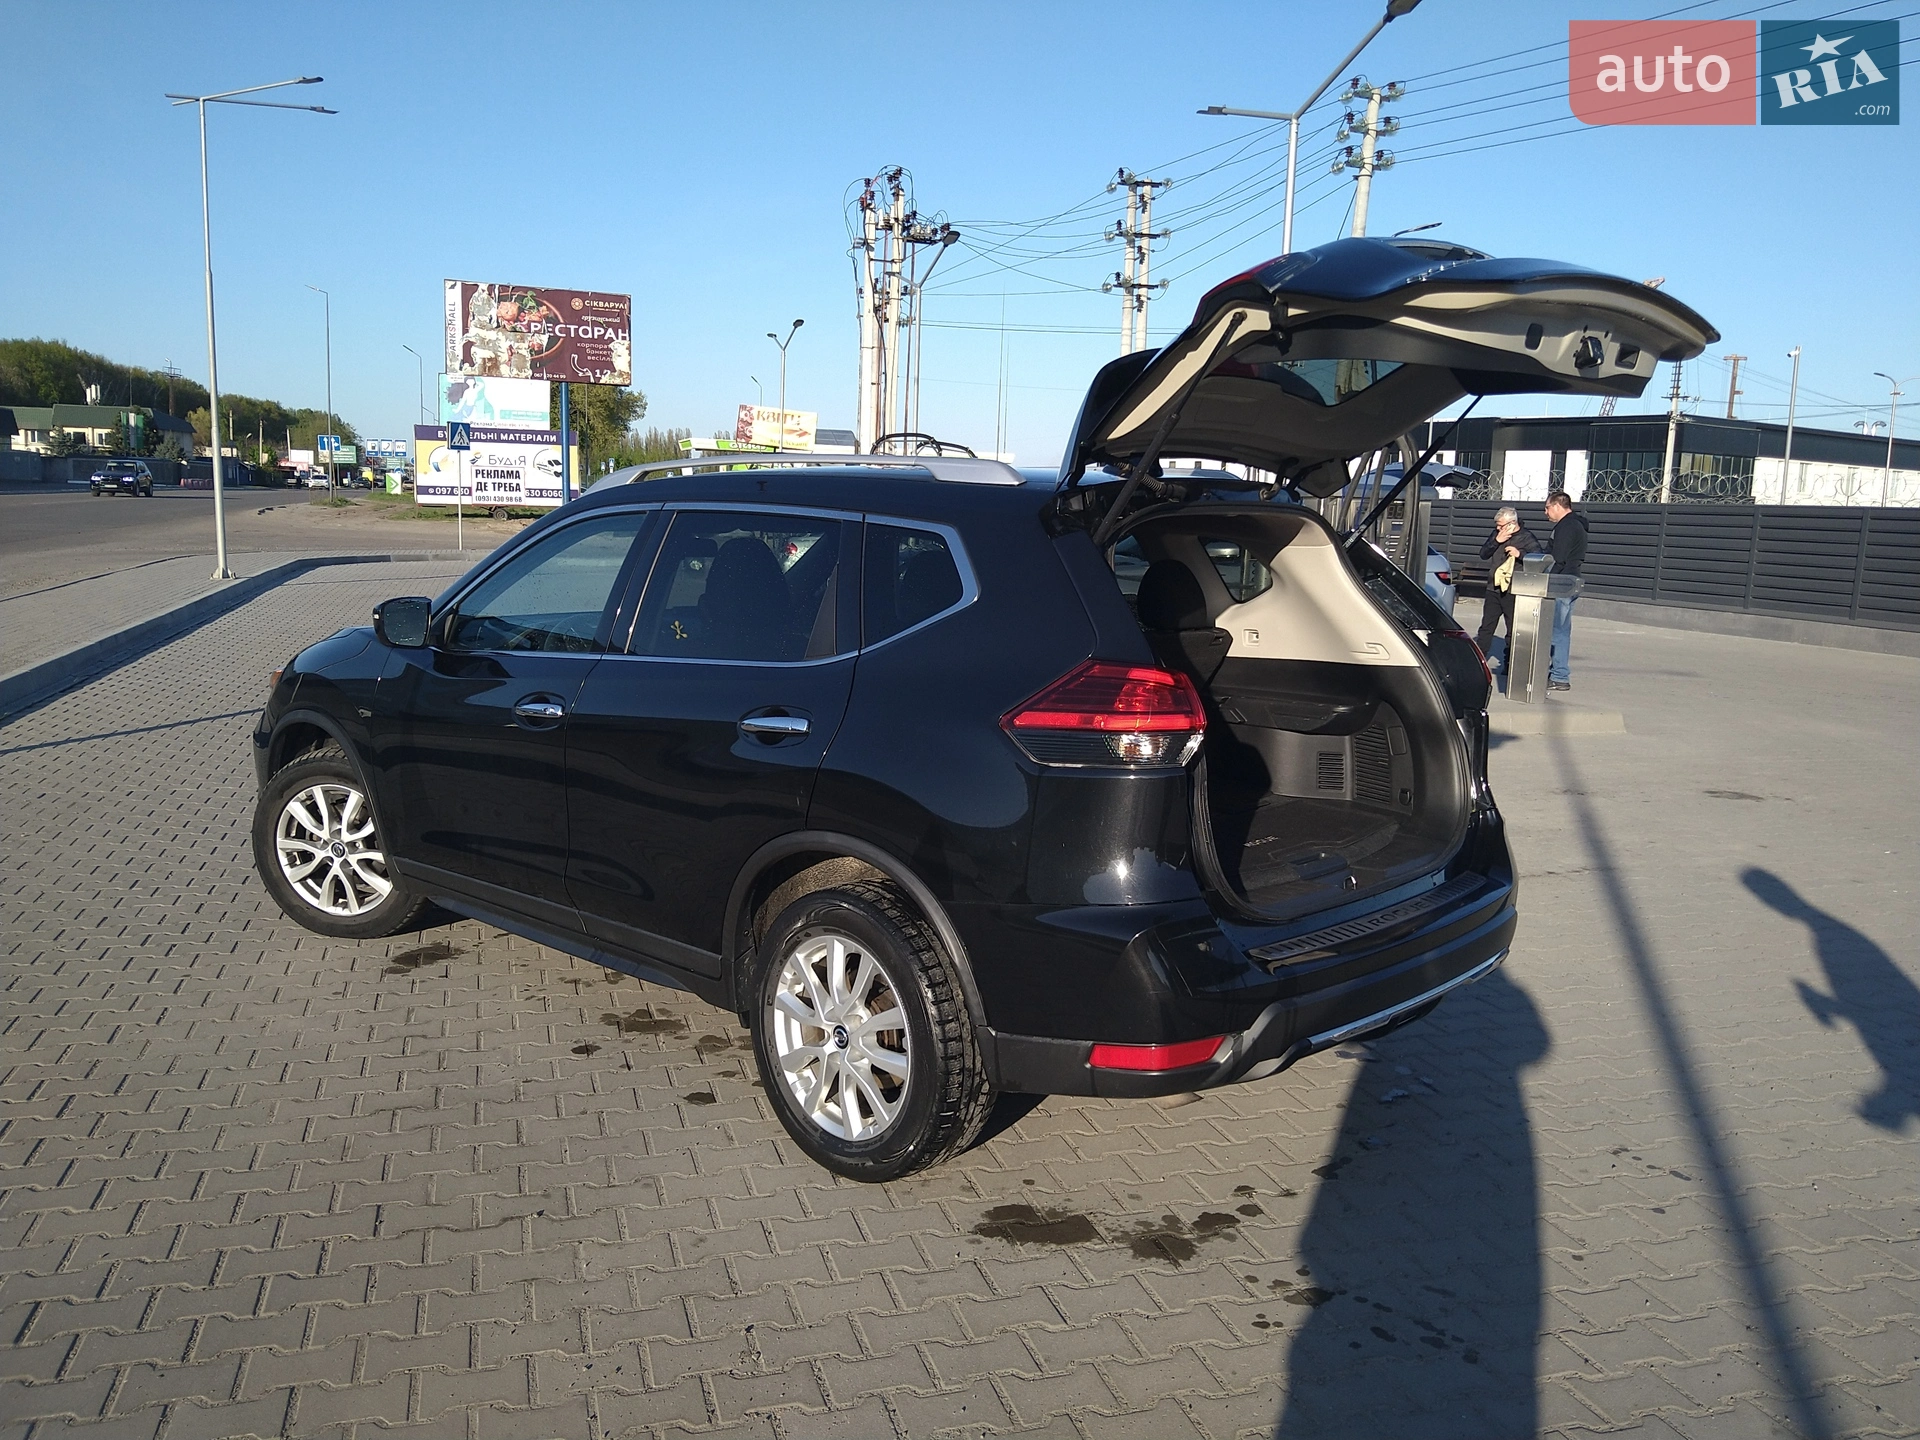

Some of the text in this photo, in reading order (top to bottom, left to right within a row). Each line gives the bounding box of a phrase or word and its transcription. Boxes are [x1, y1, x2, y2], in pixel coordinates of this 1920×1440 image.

[448, 301, 457, 352] ARKSMALL
[529, 321, 630, 341] РЕСТОРАН
[500, 432, 557, 443] МАТЕРІАЛИ
[475, 469, 521, 480] РЕКЛАМА
[475, 481, 522, 493] ДЕ ТРЕБА
